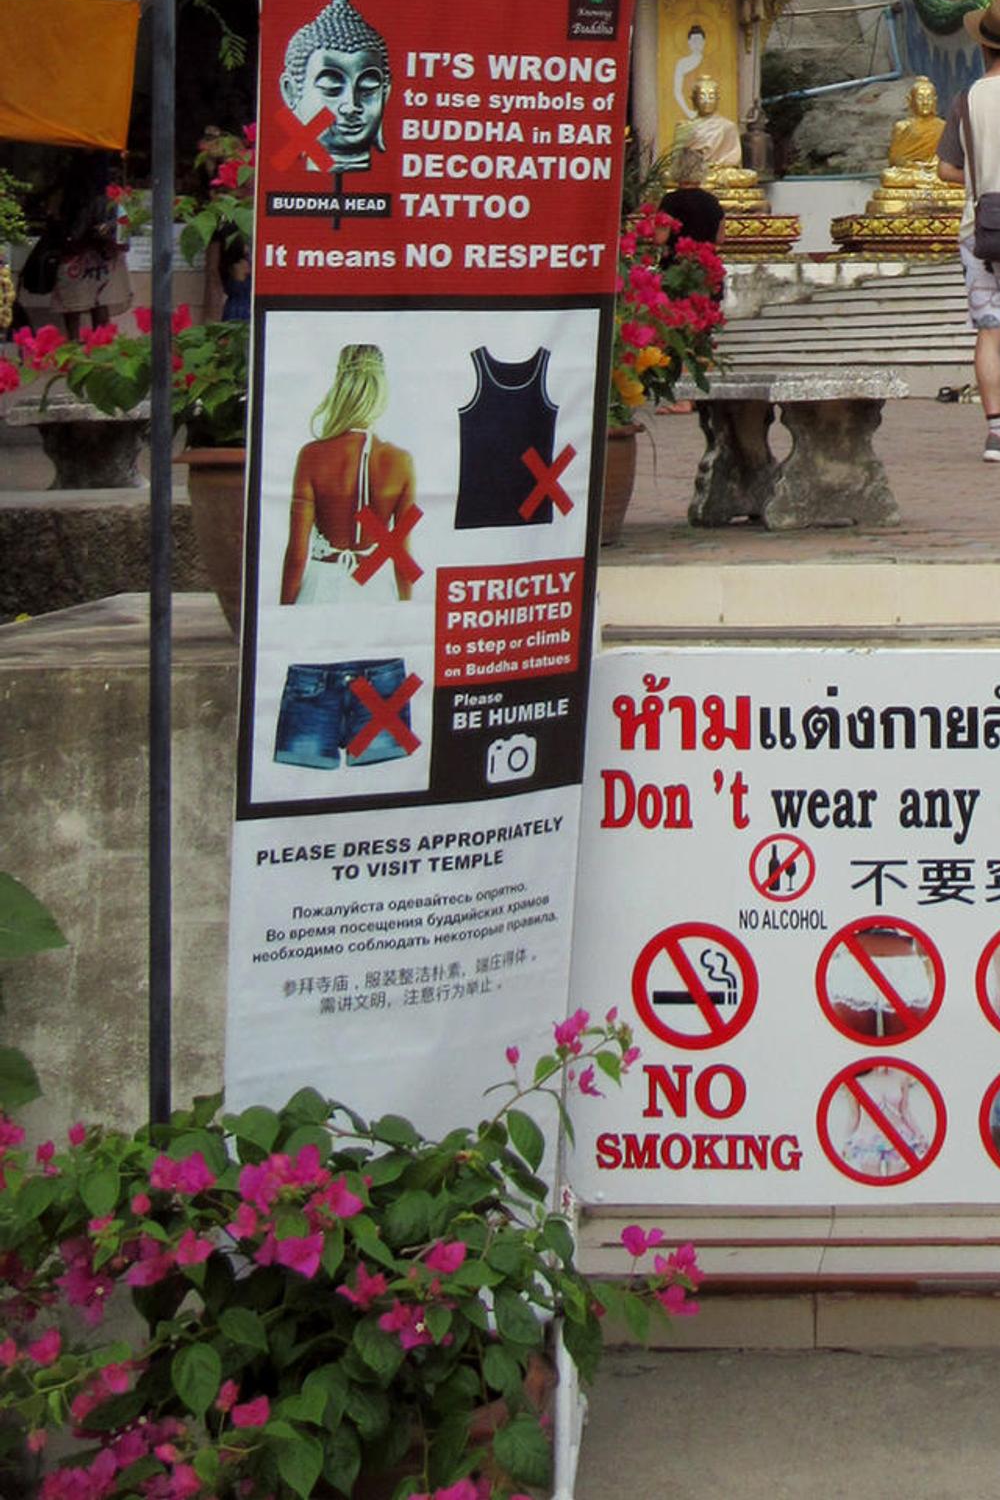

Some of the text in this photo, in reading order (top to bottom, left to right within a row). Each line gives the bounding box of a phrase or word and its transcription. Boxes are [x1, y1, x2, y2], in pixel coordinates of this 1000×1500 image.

[406, 52, 617, 82] IT’S WRONG
[403, 88, 615, 113] to use symbols of
[402, 119, 613, 145] BUDDHA in BAR
[401, 153, 612, 180] DECORATION
[273, 197, 387, 211] BUDDHA HEAD
[400, 193, 531, 219] TATTOO
[265, 244, 606, 268] It means NO RESPECT
[447, 572, 576, 603] STRICTLY
[447, 602, 573, 629] PROHIBITED
[445, 629, 571, 655] to step or climb
[444, 654, 571, 677] on Buddha statues
[454, 692, 503, 707] Please
[453, 698, 570, 730] BE HUMBLE
[771, 787, 878, 828] wear
[899, 787, 980, 844] any
[256, 816, 564, 866] PLEASE DRESS APPROPRIATELY
[332, 850, 504, 881] TO VISIT TEMPLE
[266, 894, 550, 942] Во время посещения буддийских храмов
[292, 901, 384, 919] Пожалуйста
[388, 893, 473, 912] одевайтесь
[739, 908, 828, 931] NO ALCOHOL
[252, 943, 344, 963] необходимо
[348, 934, 431, 953] соблюдать
[434, 923, 505, 945] некоторые
[642, 1063, 748, 1119] NO
[596, 1133, 803, 1171] SMOKING
